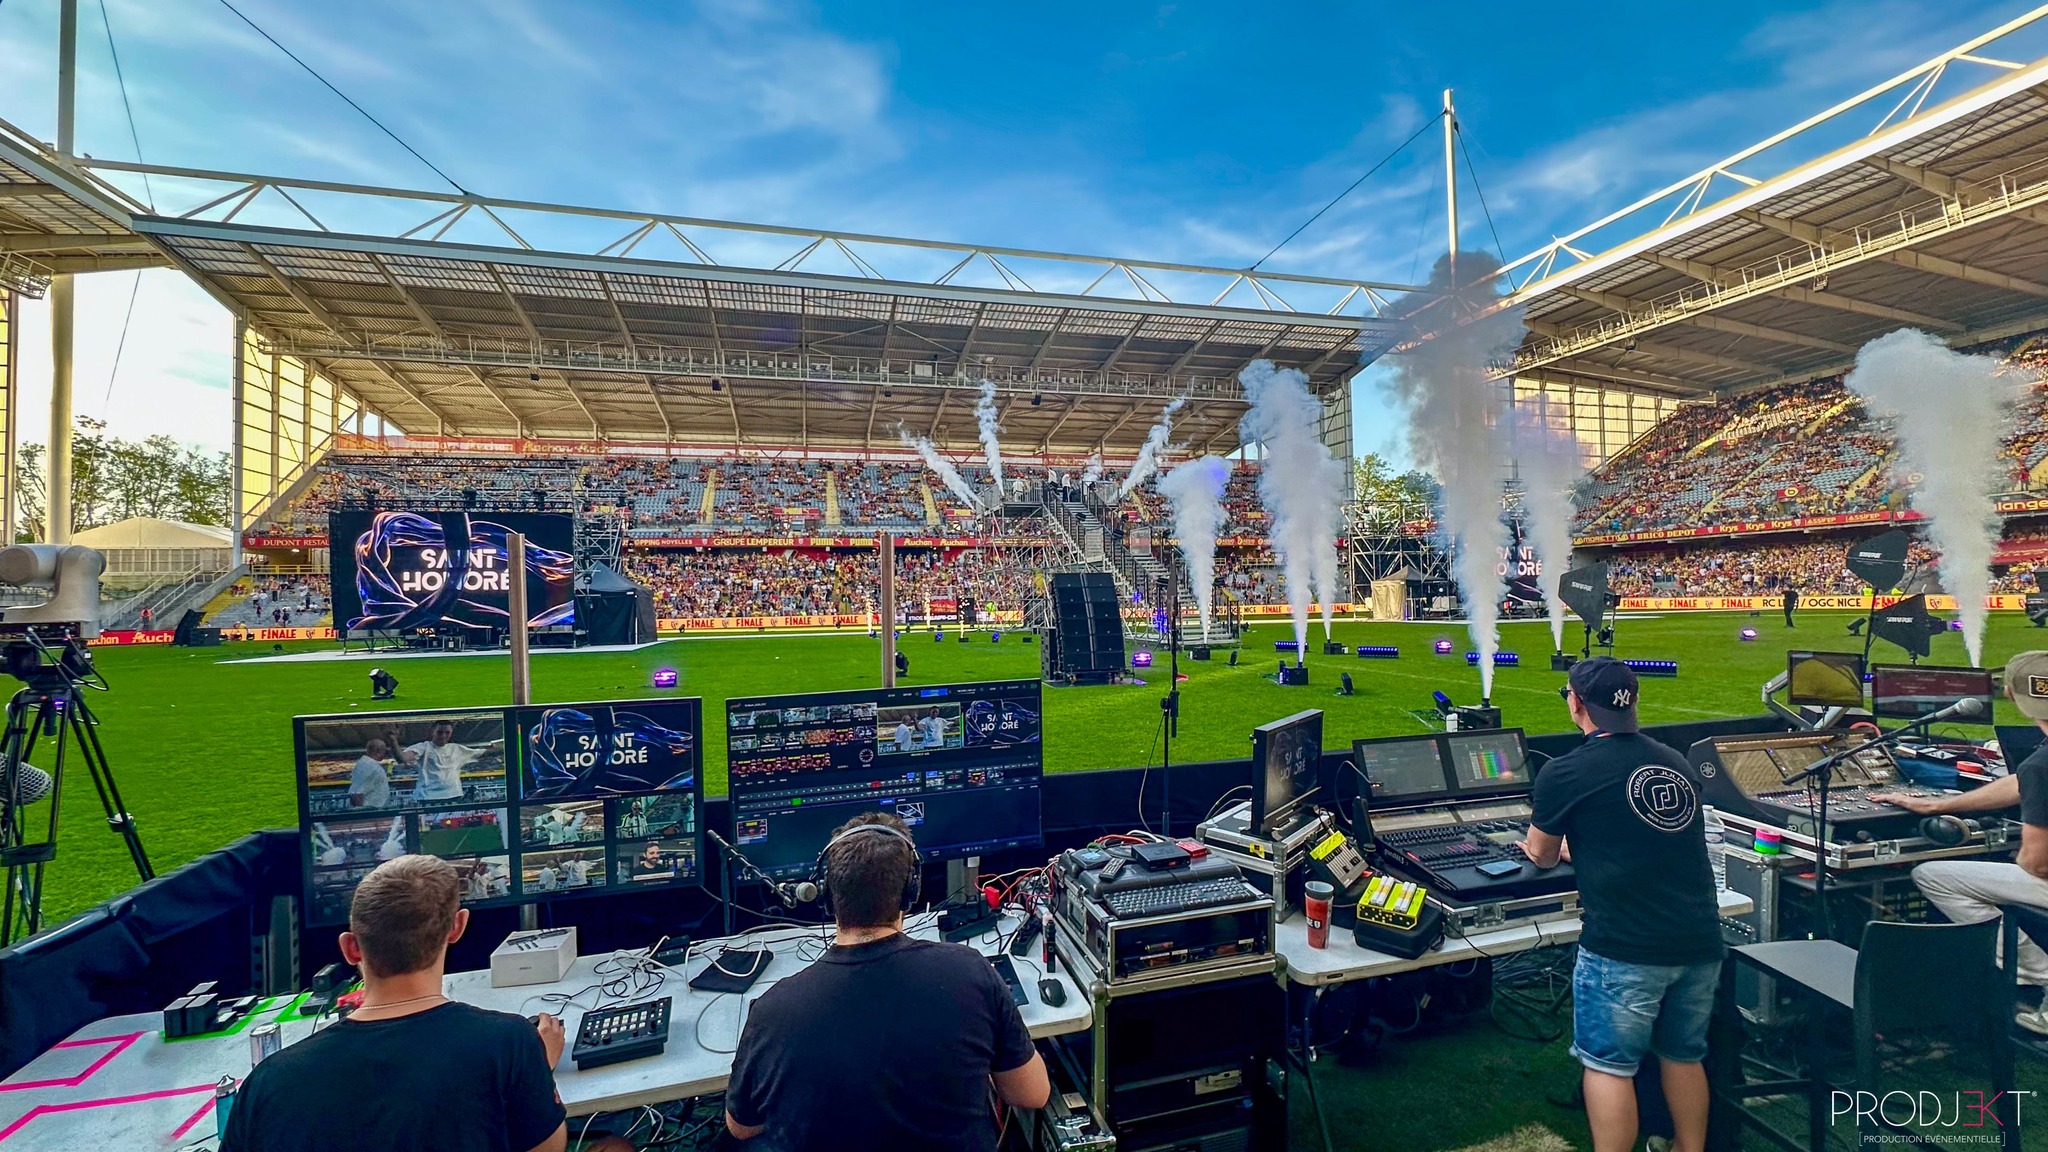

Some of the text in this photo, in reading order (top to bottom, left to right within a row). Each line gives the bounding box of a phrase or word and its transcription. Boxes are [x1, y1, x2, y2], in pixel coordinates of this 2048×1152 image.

[1719, 525, 1739, 534] Krys
[1745, 522, 1766, 532] Krys
[1771, 520, 1792, 530] Krys
[1637, 532, 1664, 540] BRICO
[263, 539, 300, 547] DUPONT
[713, 538, 794, 547] GROUPE LEMPEREUR
[1571, 581, 1594, 592] SHURE
[1623, 598, 1648, 608] FINALE
[1670, 597, 1697, 608] FINALE
[1722, 597, 1752, 608] FINALE
[1763, 599, 1776, 608] RC
[1808, 599, 1835, 608] OGC
[1838, 598, 1861, 607] NICE
[686, 618, 715, 628] FINALE
[736, 617, 763, 627] FINALE
[785, 616, 812, 626] FINALE
[261, 629, 297, 639] FINALE
[1633, 769, 1656, 798] ROBERT
